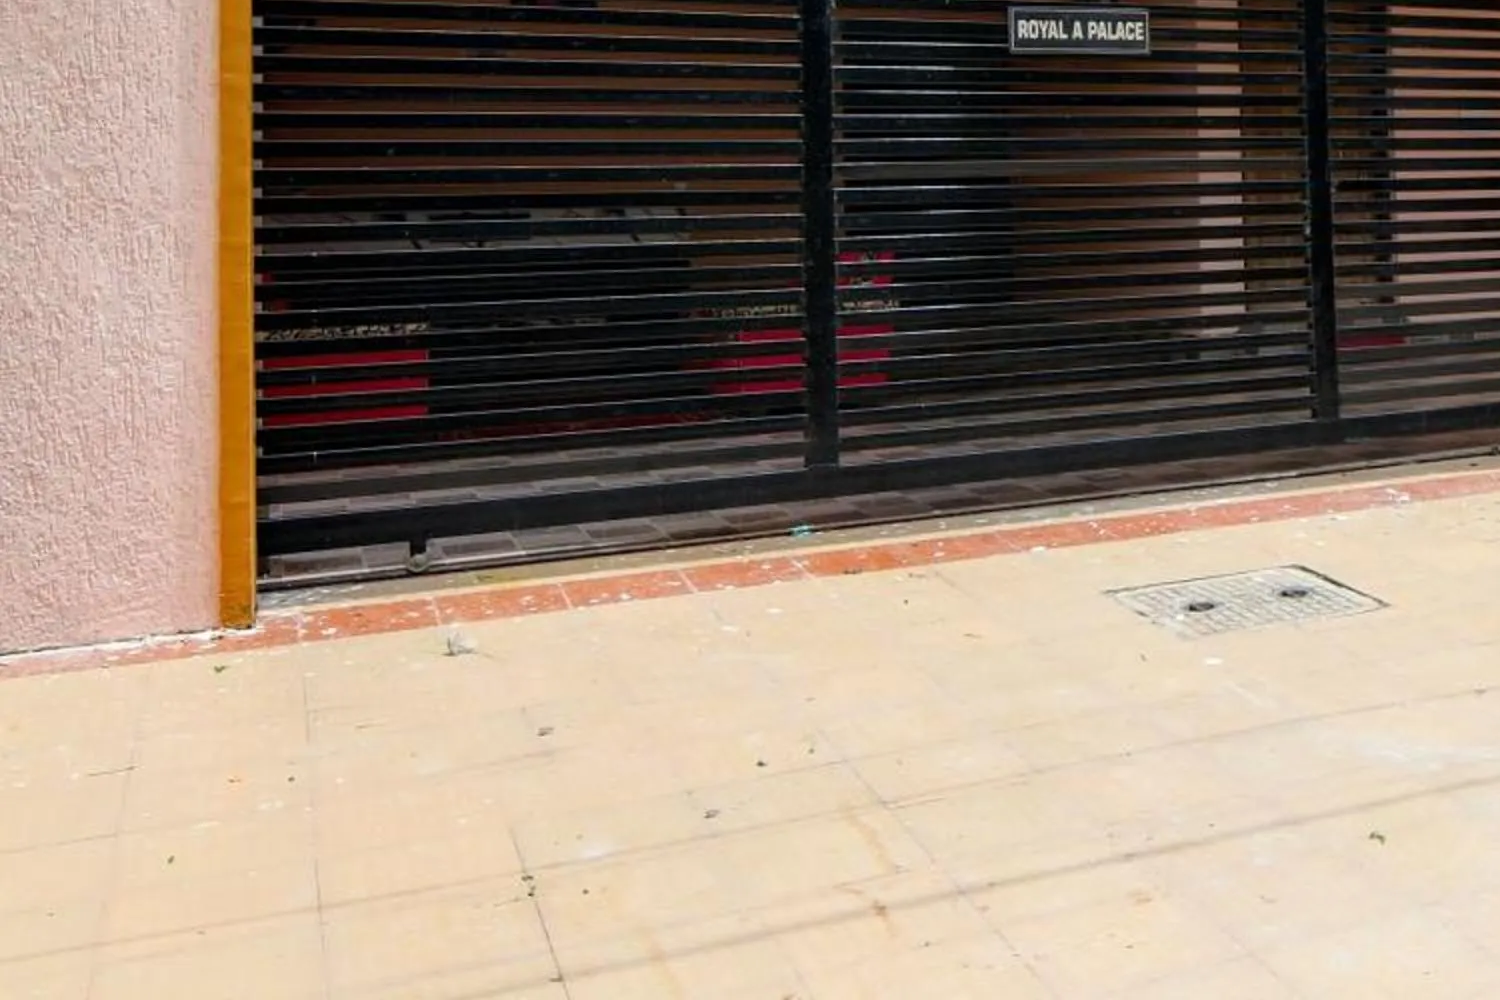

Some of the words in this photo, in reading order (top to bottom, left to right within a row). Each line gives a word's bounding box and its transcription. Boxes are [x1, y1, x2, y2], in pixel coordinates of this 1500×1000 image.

[1017, 19, 1068, 39] ROYAL
[1072, 20, 1084, 39] A
[1087, 20, 1144, 40] PALACE
